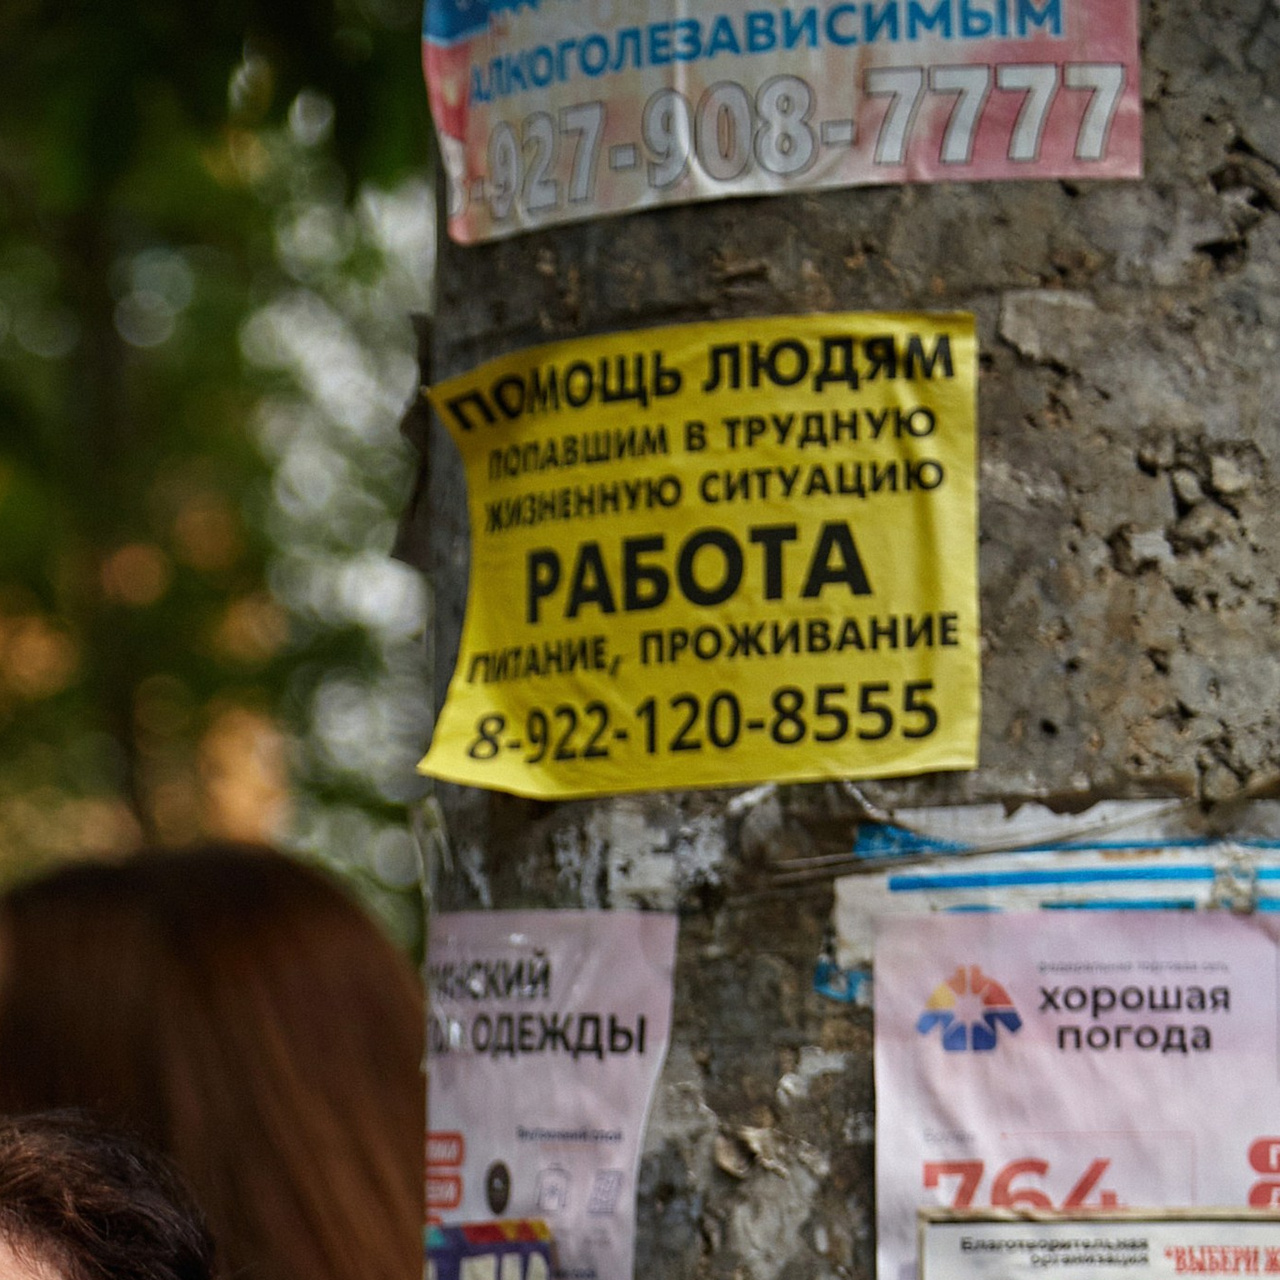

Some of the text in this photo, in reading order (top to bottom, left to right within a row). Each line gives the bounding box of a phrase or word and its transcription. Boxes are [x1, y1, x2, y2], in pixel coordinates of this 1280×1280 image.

[446, 332, 955, 432] ПОМОЩЬ ЛЮДЯМ
[488, 406, 937, 481] ПОПАВШИМ В ТРУДНУЮ
[485, 459, 945, 532] ЖИЗНЕННУЮ СИТУАЦИЮ
[525, 520, 872, 625] РАБОТА
[467, 612, 960, 685] ПИТАНИЕ, ПРОЖИВАНИЕ
[467, 679, 939, 765] 8-922-120-8555
[472, 1012, 646, 1060] ОДЕЖДЫ
[1038, 985, 1231, 1019] хорошая
[1058, 1025, 1212, 1055] погода
